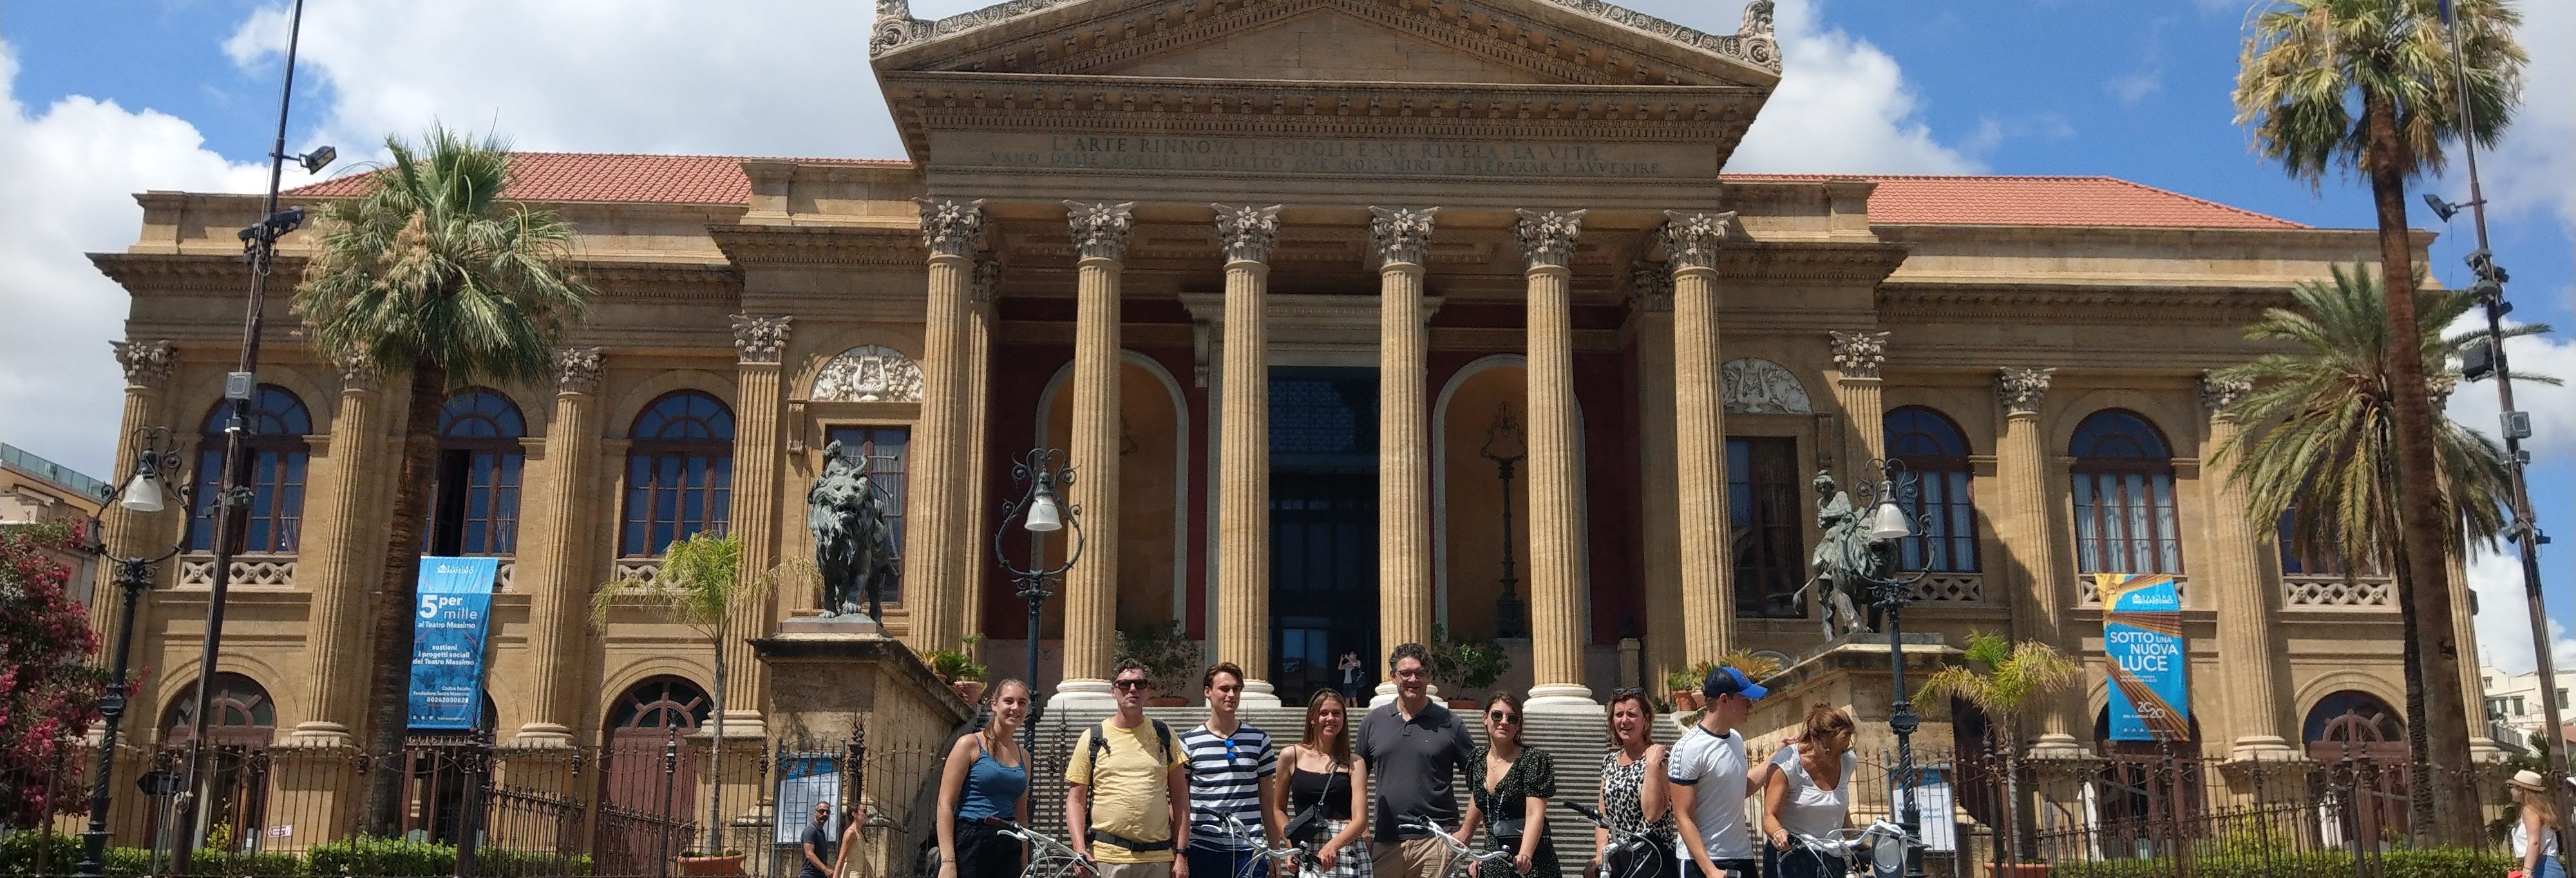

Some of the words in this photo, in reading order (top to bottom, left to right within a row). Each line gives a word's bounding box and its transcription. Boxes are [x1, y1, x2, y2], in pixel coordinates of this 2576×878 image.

[1052, 137, 1126, 152] L'ARTE
[1141, 138, 1238, 154] RINNOVA
[1271, 142, 1343, 157] POPOLI
[1422, 144, 1498, 159] RIVELA
[1513, 146, 1535, 159] LA
[1547, 145, 1599, 161] VITA
[419, 594, 437, 618] 5
[439, 596, 463, 609] per
[444, 607, 477, 619] mille
[2110, 631, 2155, 644] SOTTO
[2130, 643, 2179, 655] NUOVA
[2119, 654, 2168, 671] LUCE
